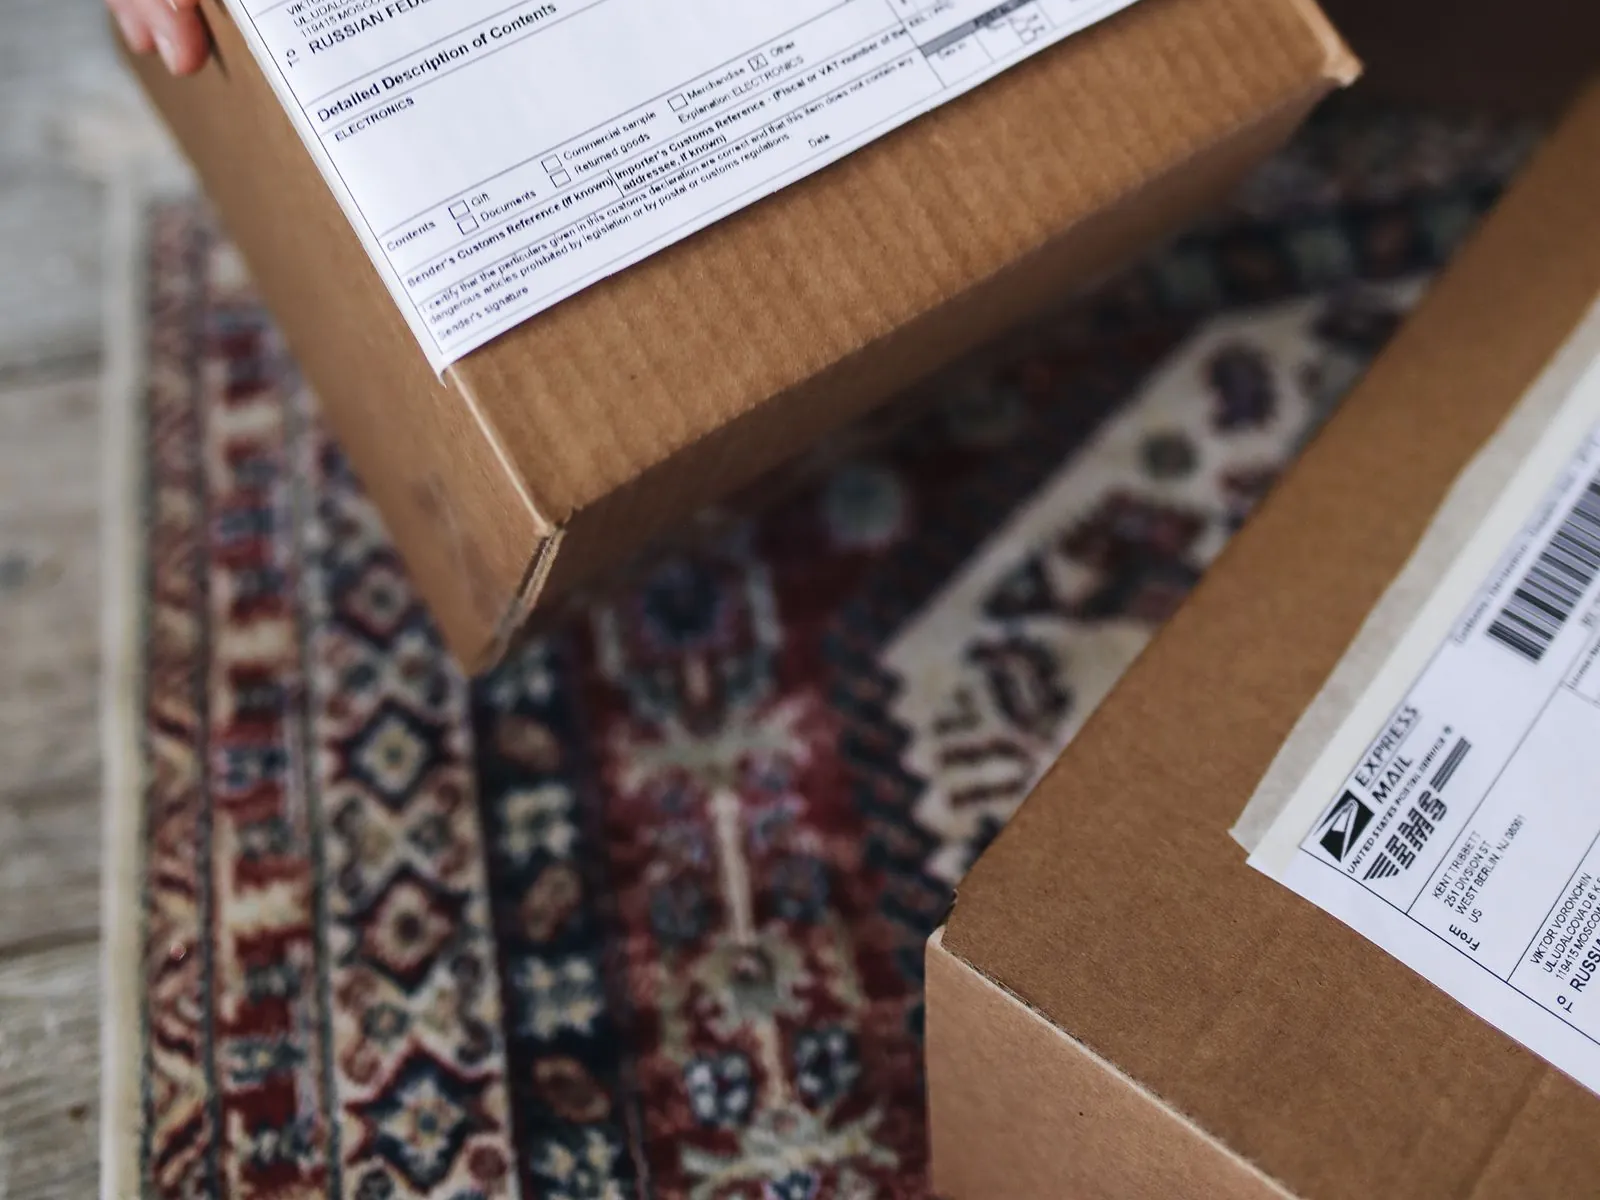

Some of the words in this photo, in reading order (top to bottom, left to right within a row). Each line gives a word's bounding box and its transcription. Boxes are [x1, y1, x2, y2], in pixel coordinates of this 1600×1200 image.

[301, 15, 337, 37] 119415
[308, 10, 384, 54] RUSSIAN
[317, 82, 380, 122] Detailed
[381, 44, 469, 90] Description
[472, 32, 487, 47] of
[489, 4, 556, 38] Contents
[686, 68, 745, 100] Merchandise
[731, 56, 804, 96] ELECTRONICS
[334, 97, 414, 141] ELECTRONICS
[563, 127, 621, 160] Commercial
[622, 111, 656, 131] sample
[614, 149, 668, 180] Importer's
[668, 126, 714, 151] Customs
[714, 100, 765, 129] Reference
[772, 78, 805, 101] (Fiscal
[806, 73, 816, 82] or
[818, 61, 838, 75] VAT
[808, 134, 830, 147] Date
[574, 147, 618, 174] Returned
[620, 133, 650, 153] goods
[623, 160, 680, 190] addressee,
[687, 134, 727, 157] known)
[429, 288, 459, 308] certify
[459, 277, 478, 291] that
[479, 270, 496, 281] the
[497, 243, 547, 275] particulars
[549, 228, 575, 247] given
[575, 223, 586, 232] in
[586, 213, 605, 227] this
[606, 193, 647, 216] customs
[648, 166, 699, 195] declaration
[700, 158, 715, 168] are
[717, 139, 749, 160] correct
[750, 128, 768, 143] and
[767, 120, 785, 133] that
[785, 112, 803, 124] this
[471, 193, 490, 206] Gift
[480, 190, 536, 221] Documents
[387, 221, 436, 249] Contents
[407, 257, 456, 286] Sender's
[457, 231, 505, 259] Customs
[506, 204, 560, 235] Reference
[573, 176, 613, 201] known)
[430, 292, 482, 323] dangerous
[483, 272, 518, 294] articles
[519, 244, 568, 277] prohibited
[568, 239, 582, 250] by
[582, 214, 631, 242] legislation
[633, 208, 642, 216] or
[643, 200, 657, 211] by
[658, 184, 687, 206] postal
[688, 179, 698, 188] or
[700, 159, 739, 182] customs
[438, 311, 483, 340] Sender's
[484, 286, 528, 314] signature
[1354, 705, 1417, 787] EXPRESS
[1371, 756, 1412, 804] MAIL
[1347, 837, 1374, 873] UNITED
[1372, 805, 1397, 838] STATES
[1394, 774, 1421, 805] POSTAL
[1380, 790, 1447, 870] EMS
[1432, 872, 1452, 899] KENT
[1447, 830, 1480, 873] TRIBBETT
[1443, 889, 1459, 907] 251
[1454, 852, 1484, 890] DIVSION
[1478, 839, 1490, 854] ST
[1454, 885, 1478, 914] WEST
[1473, 852, 1503, 887] BERLIN,
[1495, 839, 1510, 851] NJ
[1448, 923, 1480, 951] From
[1468, 908, 1482, 923] US
[1529, 928, 1558, 963] VIKTOR
[1551, 872, 1592, 928] VORONCHIN
[1555, 947, 1579, 980] 119415
[1556, 995, 1573, 1013] To
